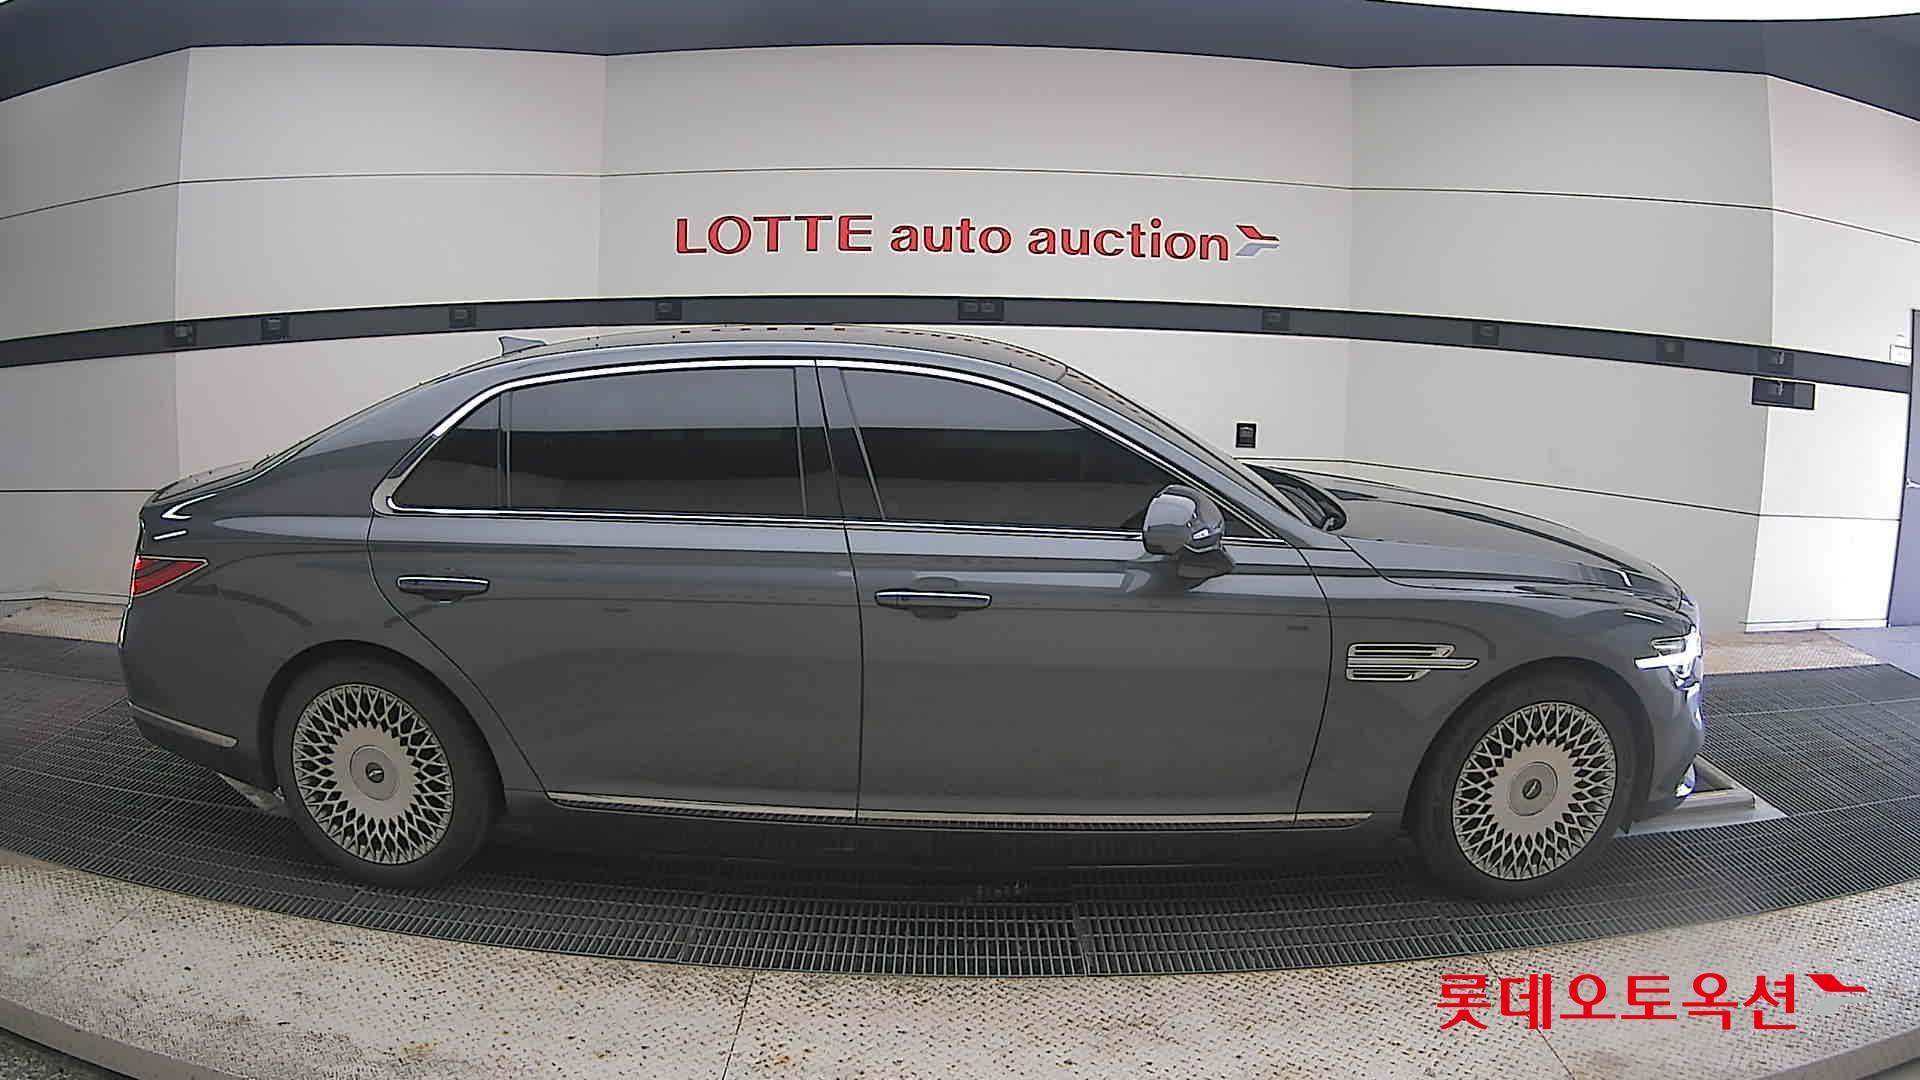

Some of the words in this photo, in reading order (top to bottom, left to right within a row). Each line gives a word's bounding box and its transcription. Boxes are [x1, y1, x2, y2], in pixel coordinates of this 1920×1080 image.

[675, 215, 873, 254] LOTTE
[890, 218, 1012, 254] auto
[1028, 218, 1229, 261] auction
